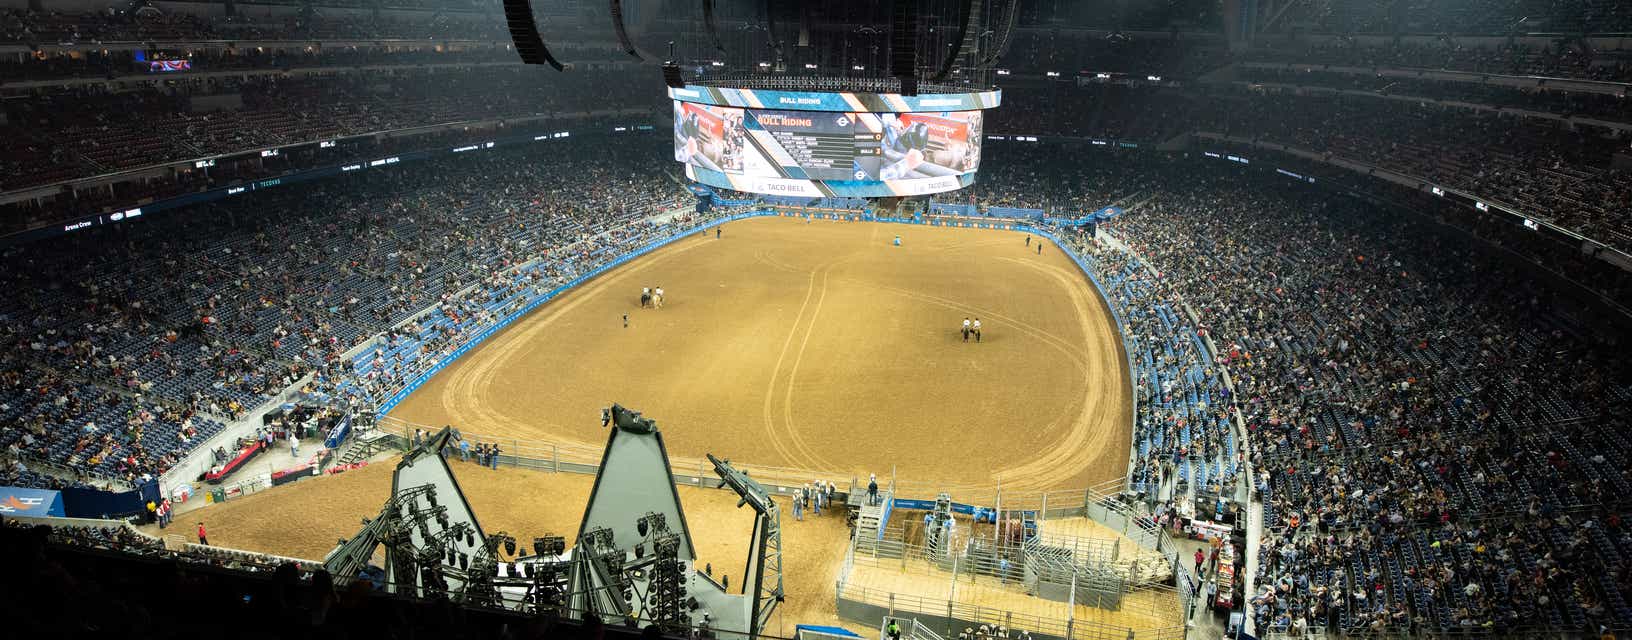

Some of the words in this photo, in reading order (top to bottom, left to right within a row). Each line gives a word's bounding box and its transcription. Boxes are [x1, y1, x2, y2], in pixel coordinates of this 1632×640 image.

[798, 97, 821, 105] RIDING
[758, 117, 780, 126] BULL
[782, 117, 812, 127] RIDING
[768, 184, 786, 192] TACO
[787, 184, 806, 193] BELL
